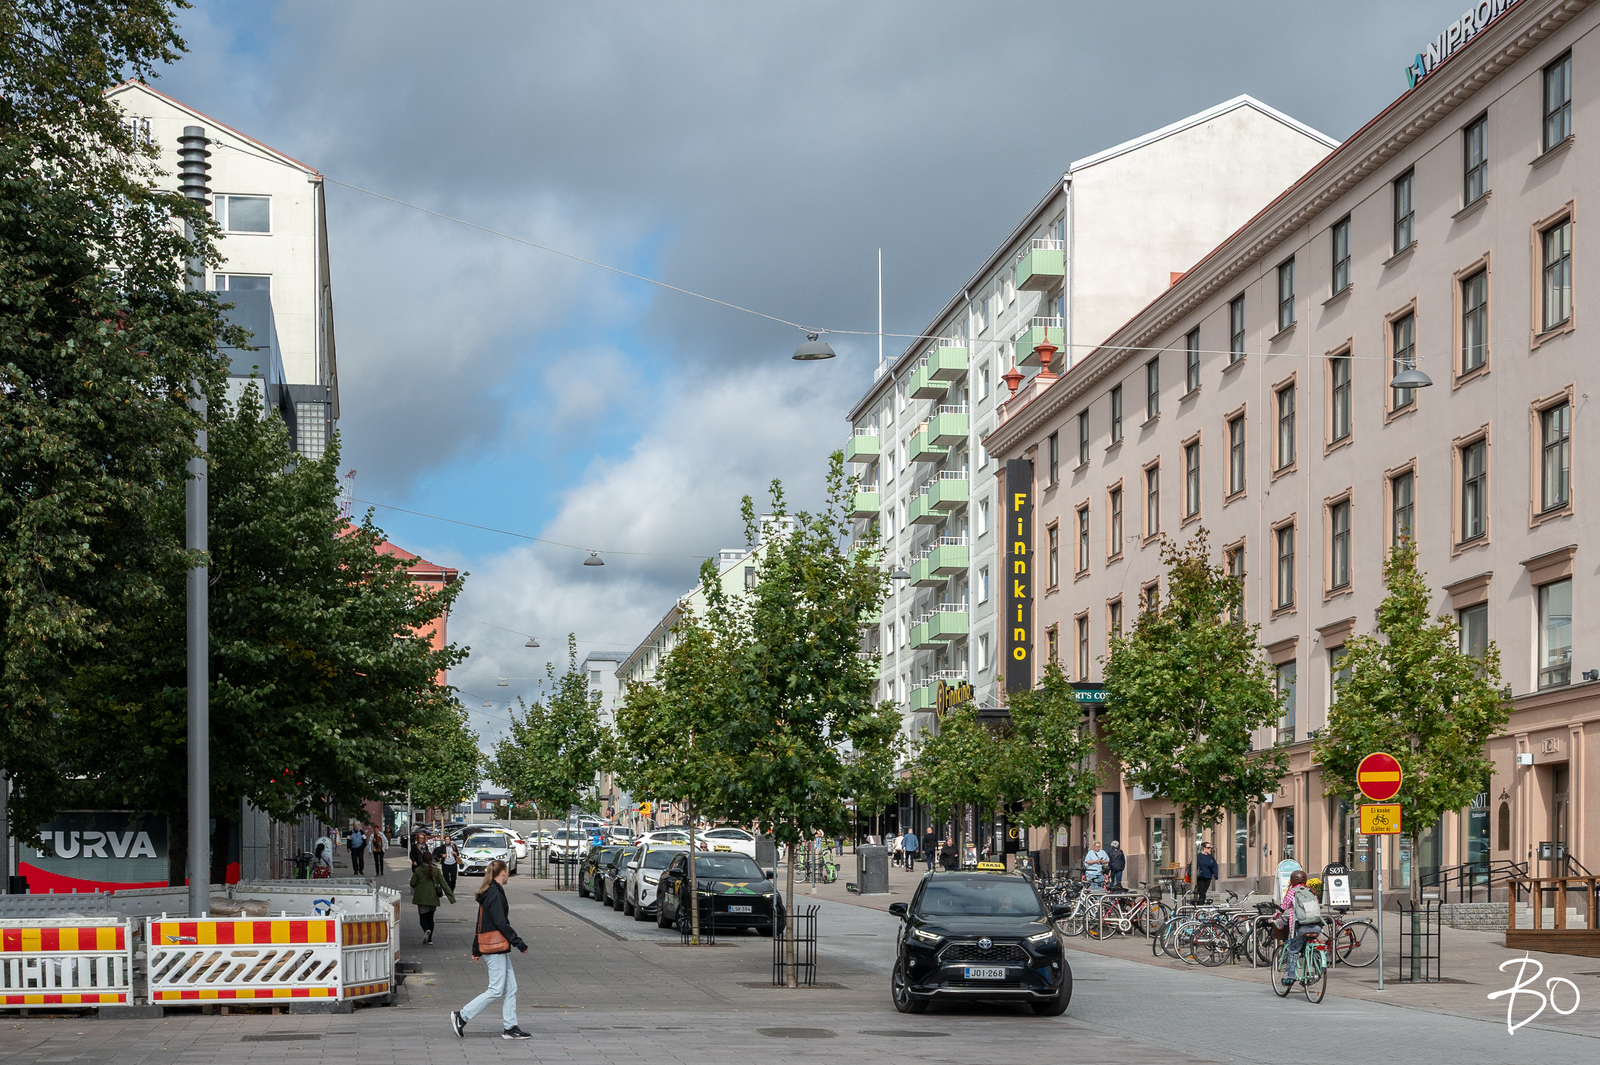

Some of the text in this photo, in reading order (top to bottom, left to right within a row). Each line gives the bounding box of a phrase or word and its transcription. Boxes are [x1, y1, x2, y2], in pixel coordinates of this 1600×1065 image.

[1013, 493, 1027, 661] Finnkino
[36, 830, 158, 859] TURVA
[1329, 866, 1345, 875] SØT
[970, 969, 1004, 978] JOI-268
